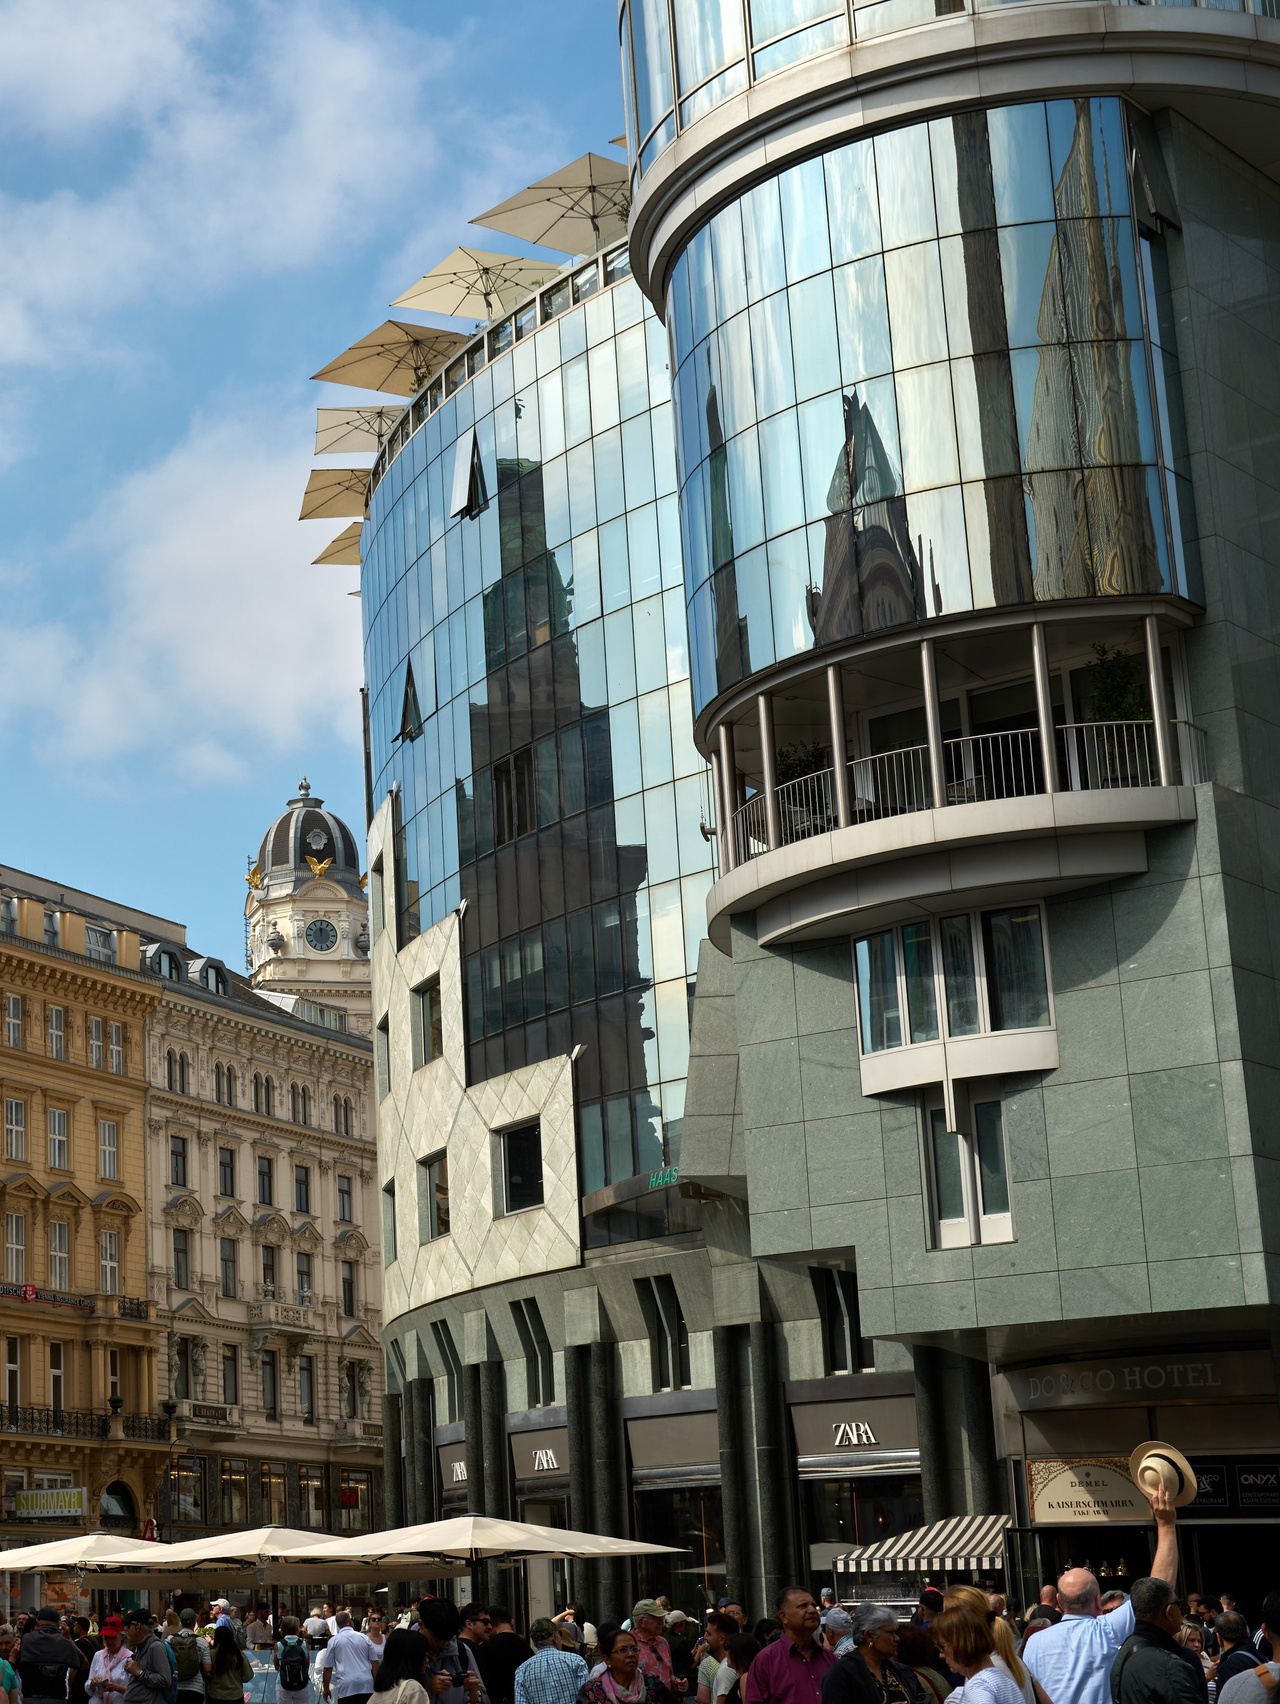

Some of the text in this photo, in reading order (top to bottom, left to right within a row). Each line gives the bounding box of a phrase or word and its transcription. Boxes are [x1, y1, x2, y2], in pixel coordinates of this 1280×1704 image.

[649, 1166, 679, 1189] HAAS
[1029, 1376, 1056, 1400] DO
[1078, 1369, 1116, 1393] CO
[1122, 1363, 1221, 1391] HOTEL
[832, 1421, 879, 1447] ZARA
[532, 1449, 559, 1471] ZARA
[451, 1461, 468, 1482] ZARA
[1240, 1474, 1278, 1485] ONYX
[1070, 1480, 1108, 1488] DEMEL
[20, 1490, 78, 1511] STURMAYR
[1048, 1499, 1134, 1509] KAISERSCHMARRN
